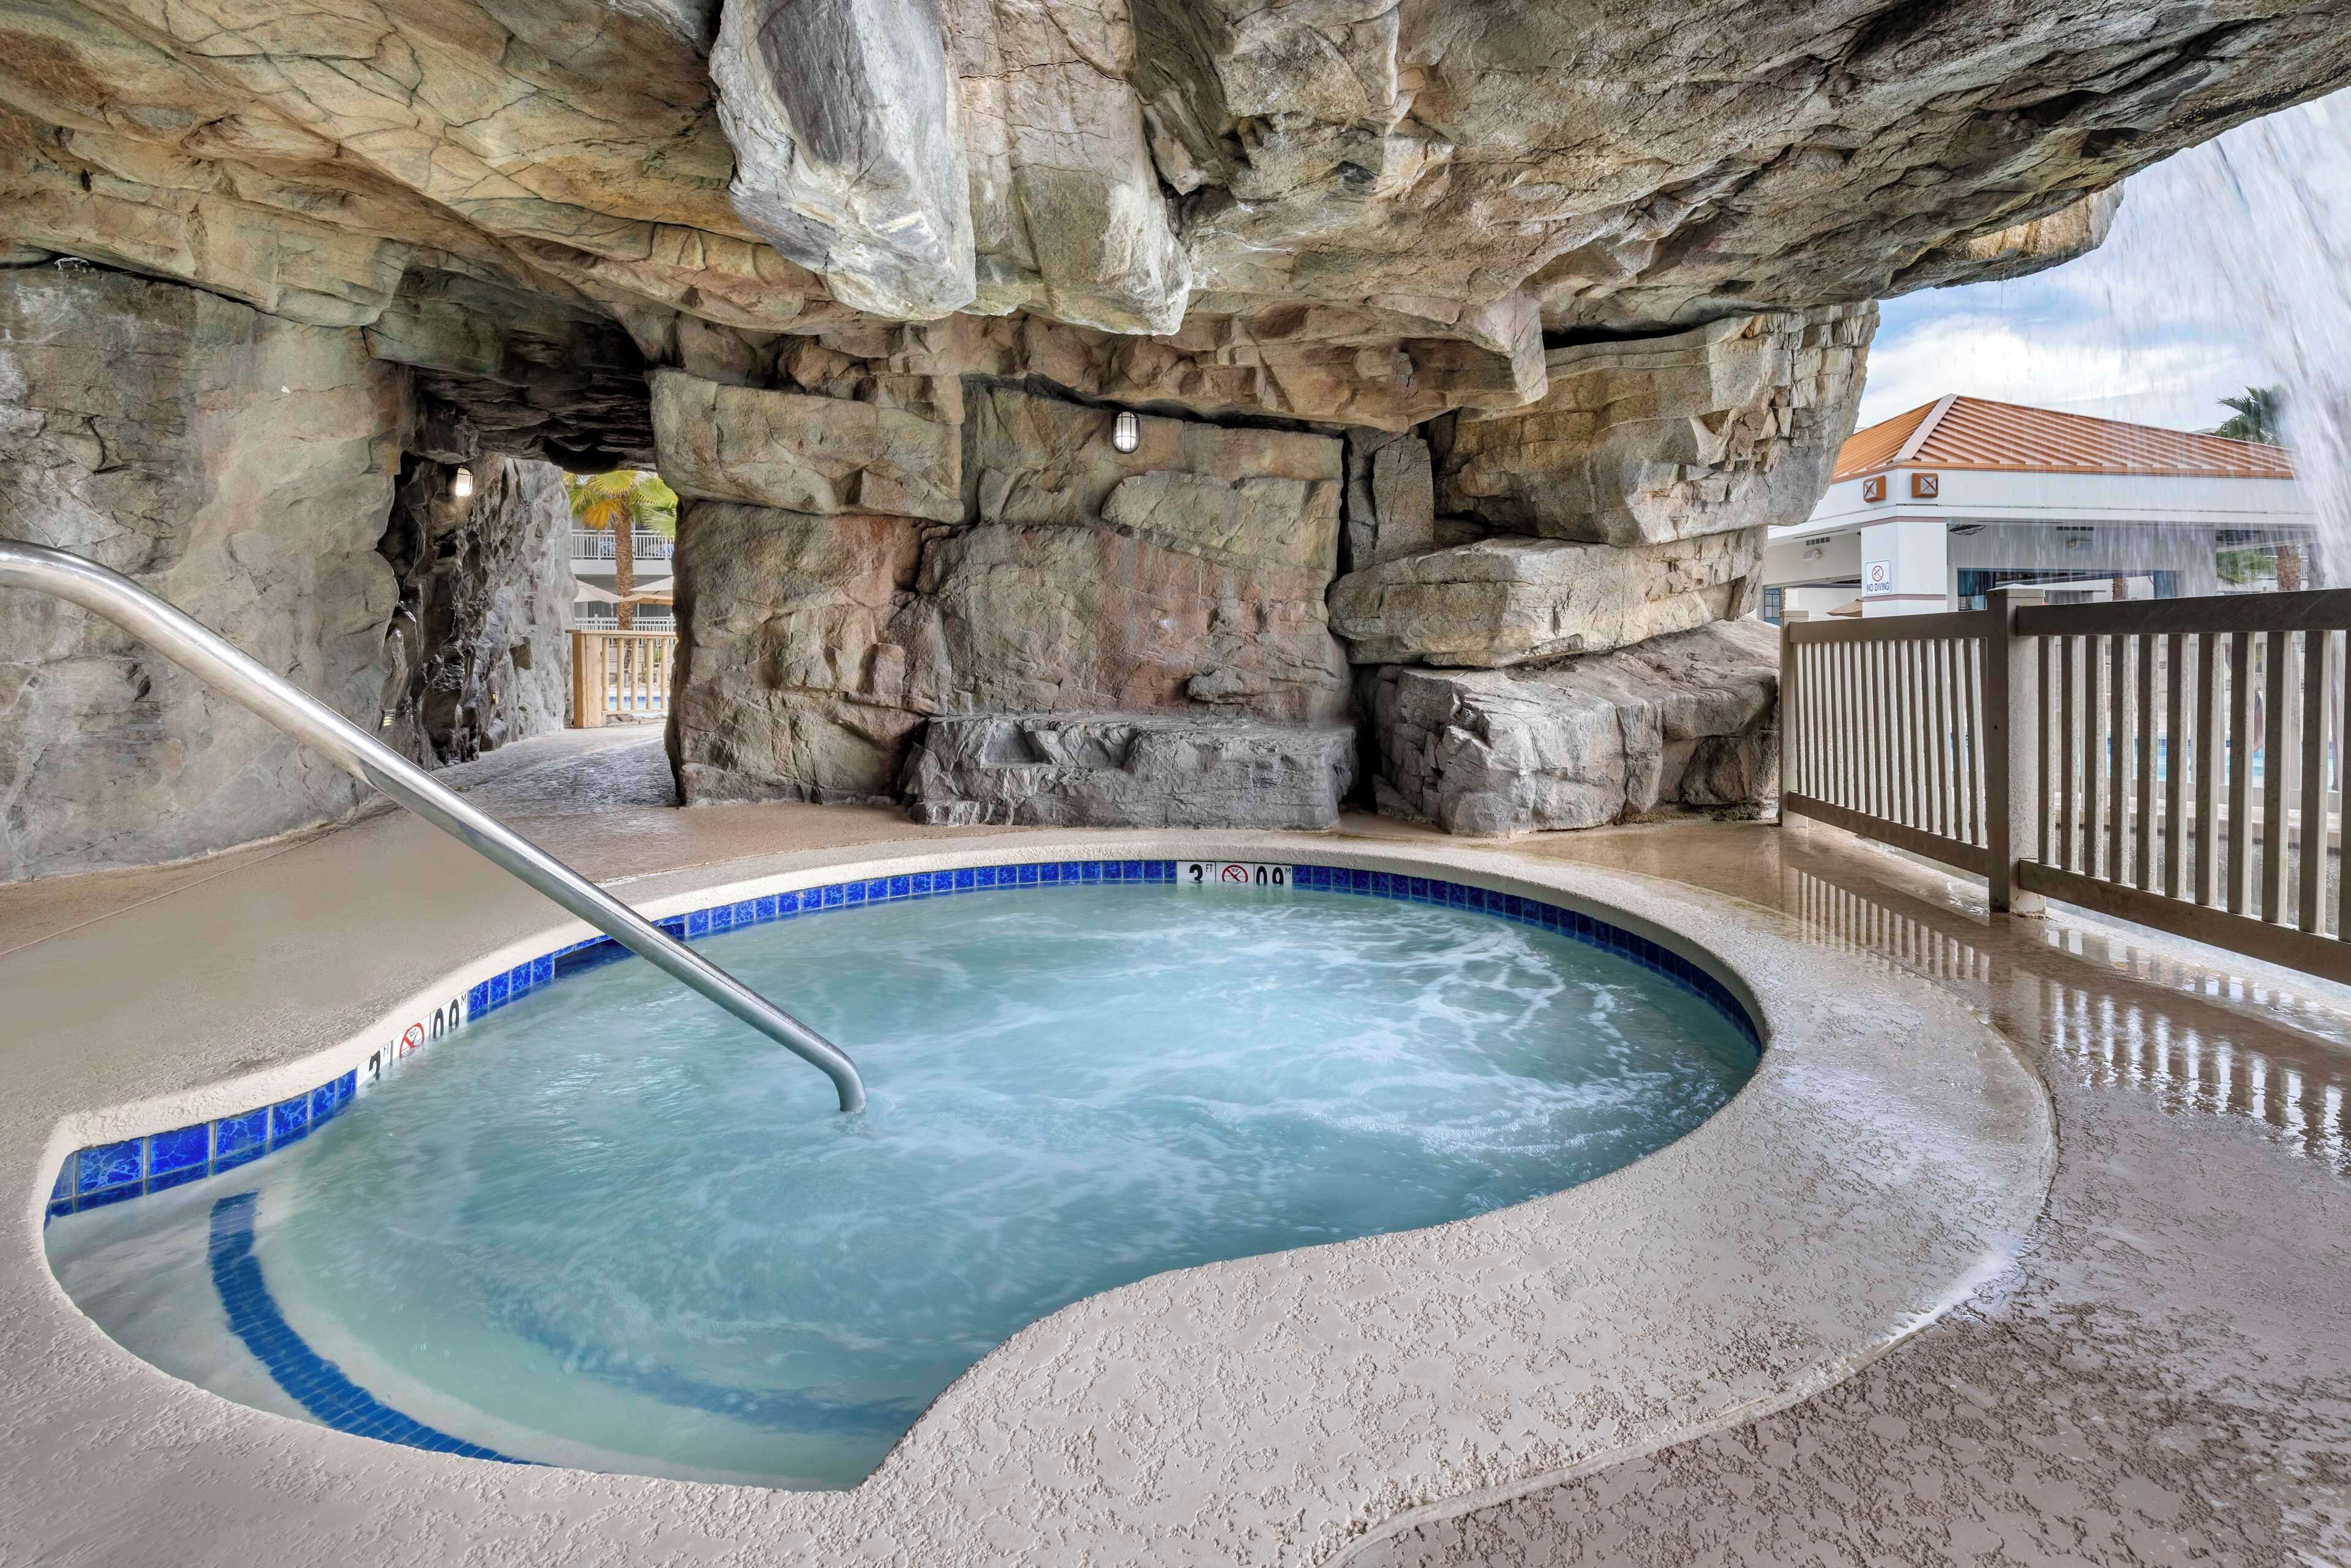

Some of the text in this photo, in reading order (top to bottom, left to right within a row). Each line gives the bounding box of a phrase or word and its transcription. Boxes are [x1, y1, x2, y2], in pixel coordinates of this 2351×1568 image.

[1875, 582, 1889, 591] DIVING
[1206, 864, 1213, 872] FT
[461, 992, 467, 1006] M
